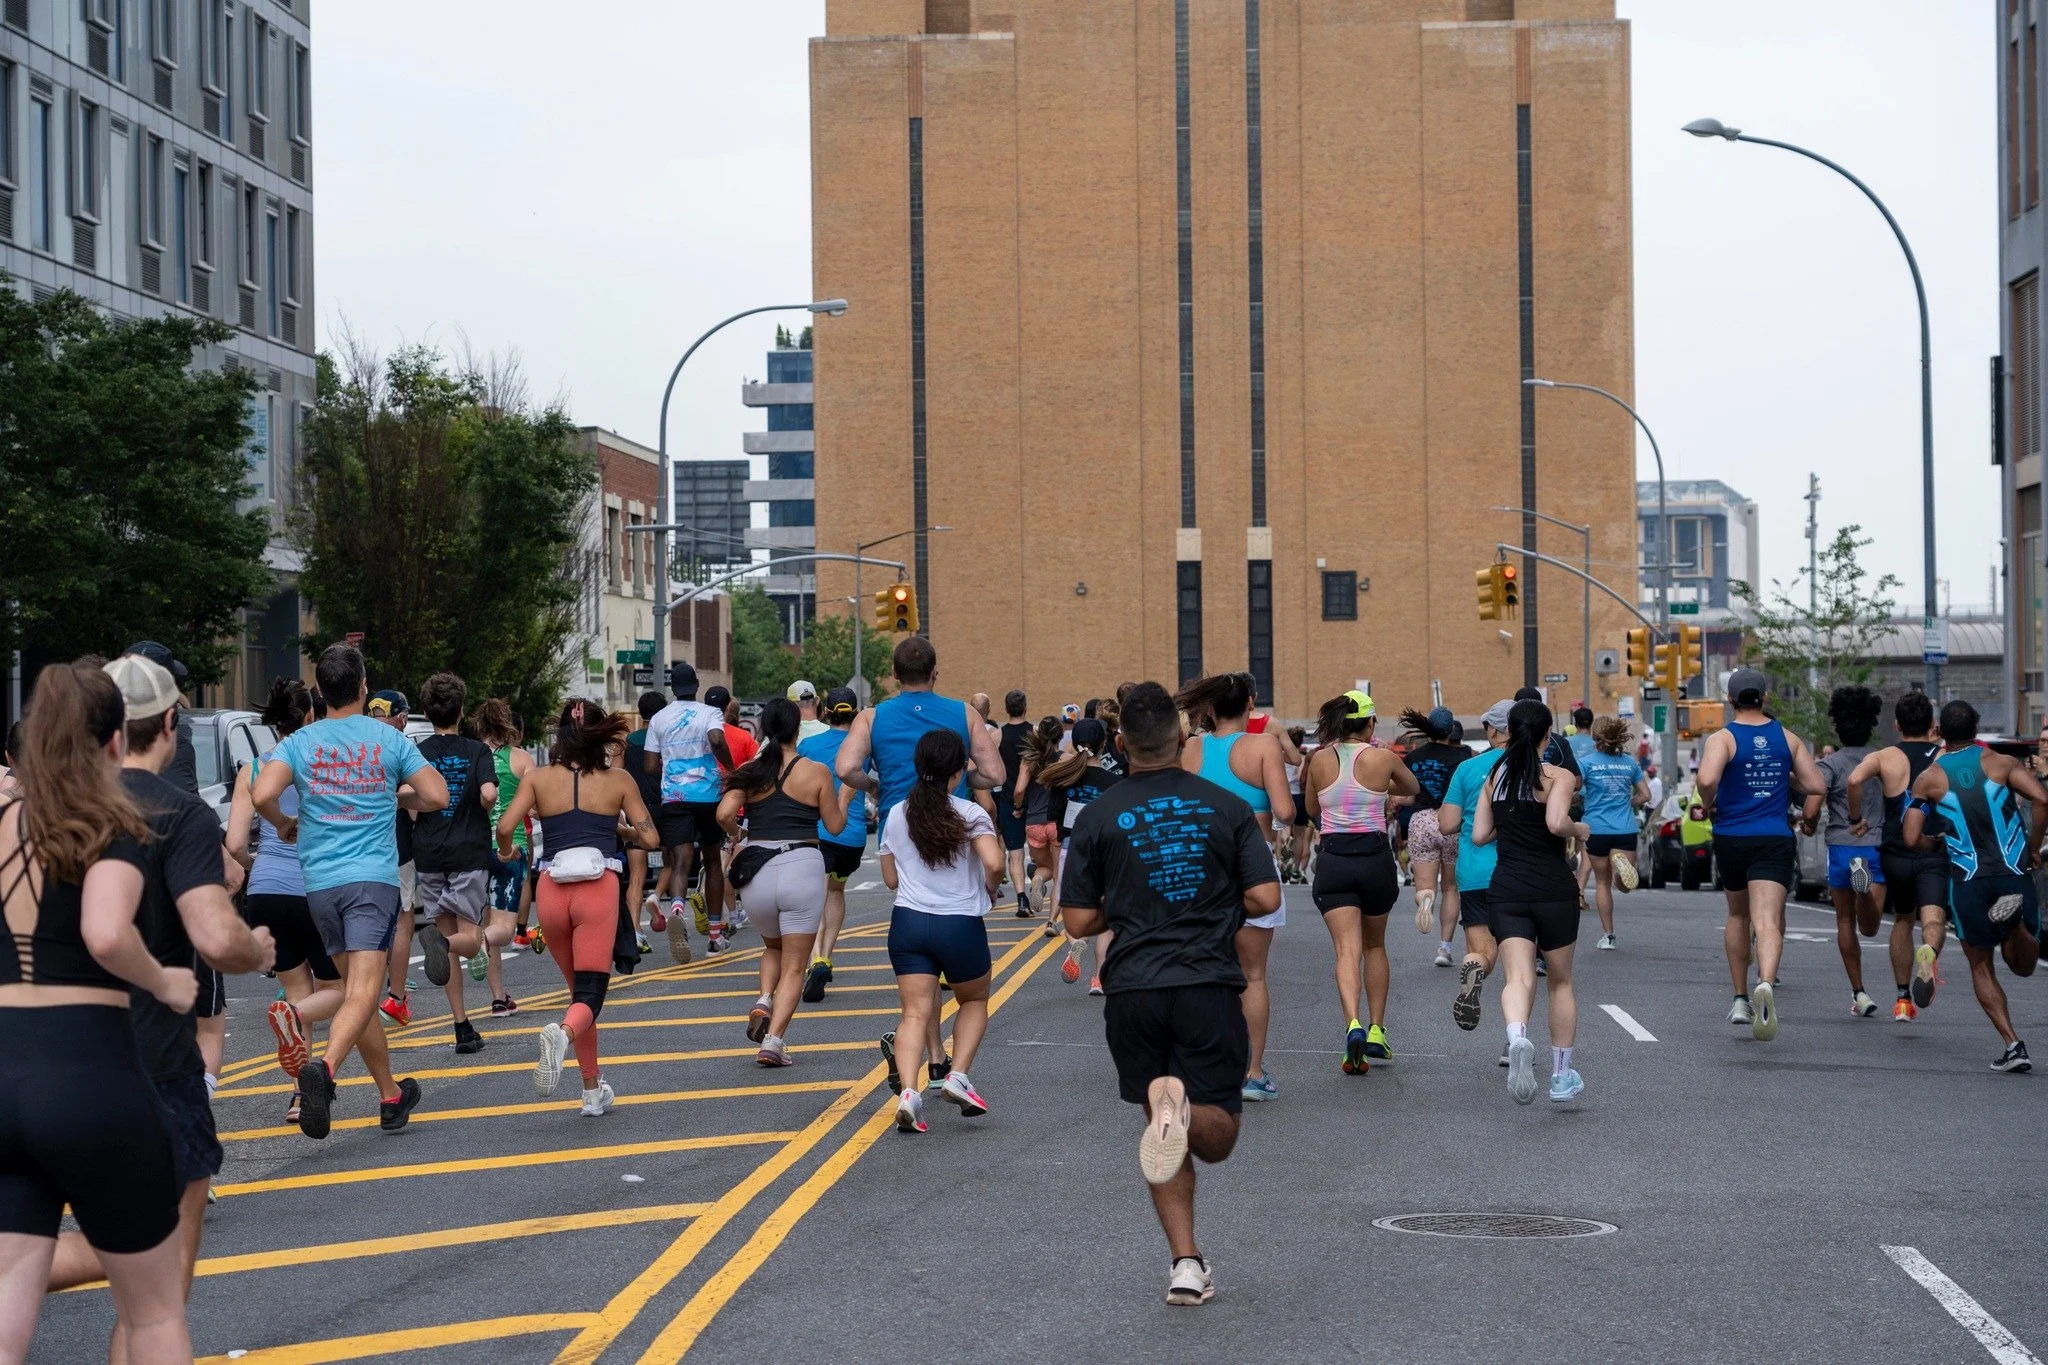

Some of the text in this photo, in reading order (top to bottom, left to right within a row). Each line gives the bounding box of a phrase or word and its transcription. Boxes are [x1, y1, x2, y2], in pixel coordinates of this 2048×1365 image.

[625, 652, 631, 662] 2
[307, 741, 383, 769] CRAFT
[305, 763, 386, 785] CULTURE
[309, 781, 386, 795] COMMUNITY
